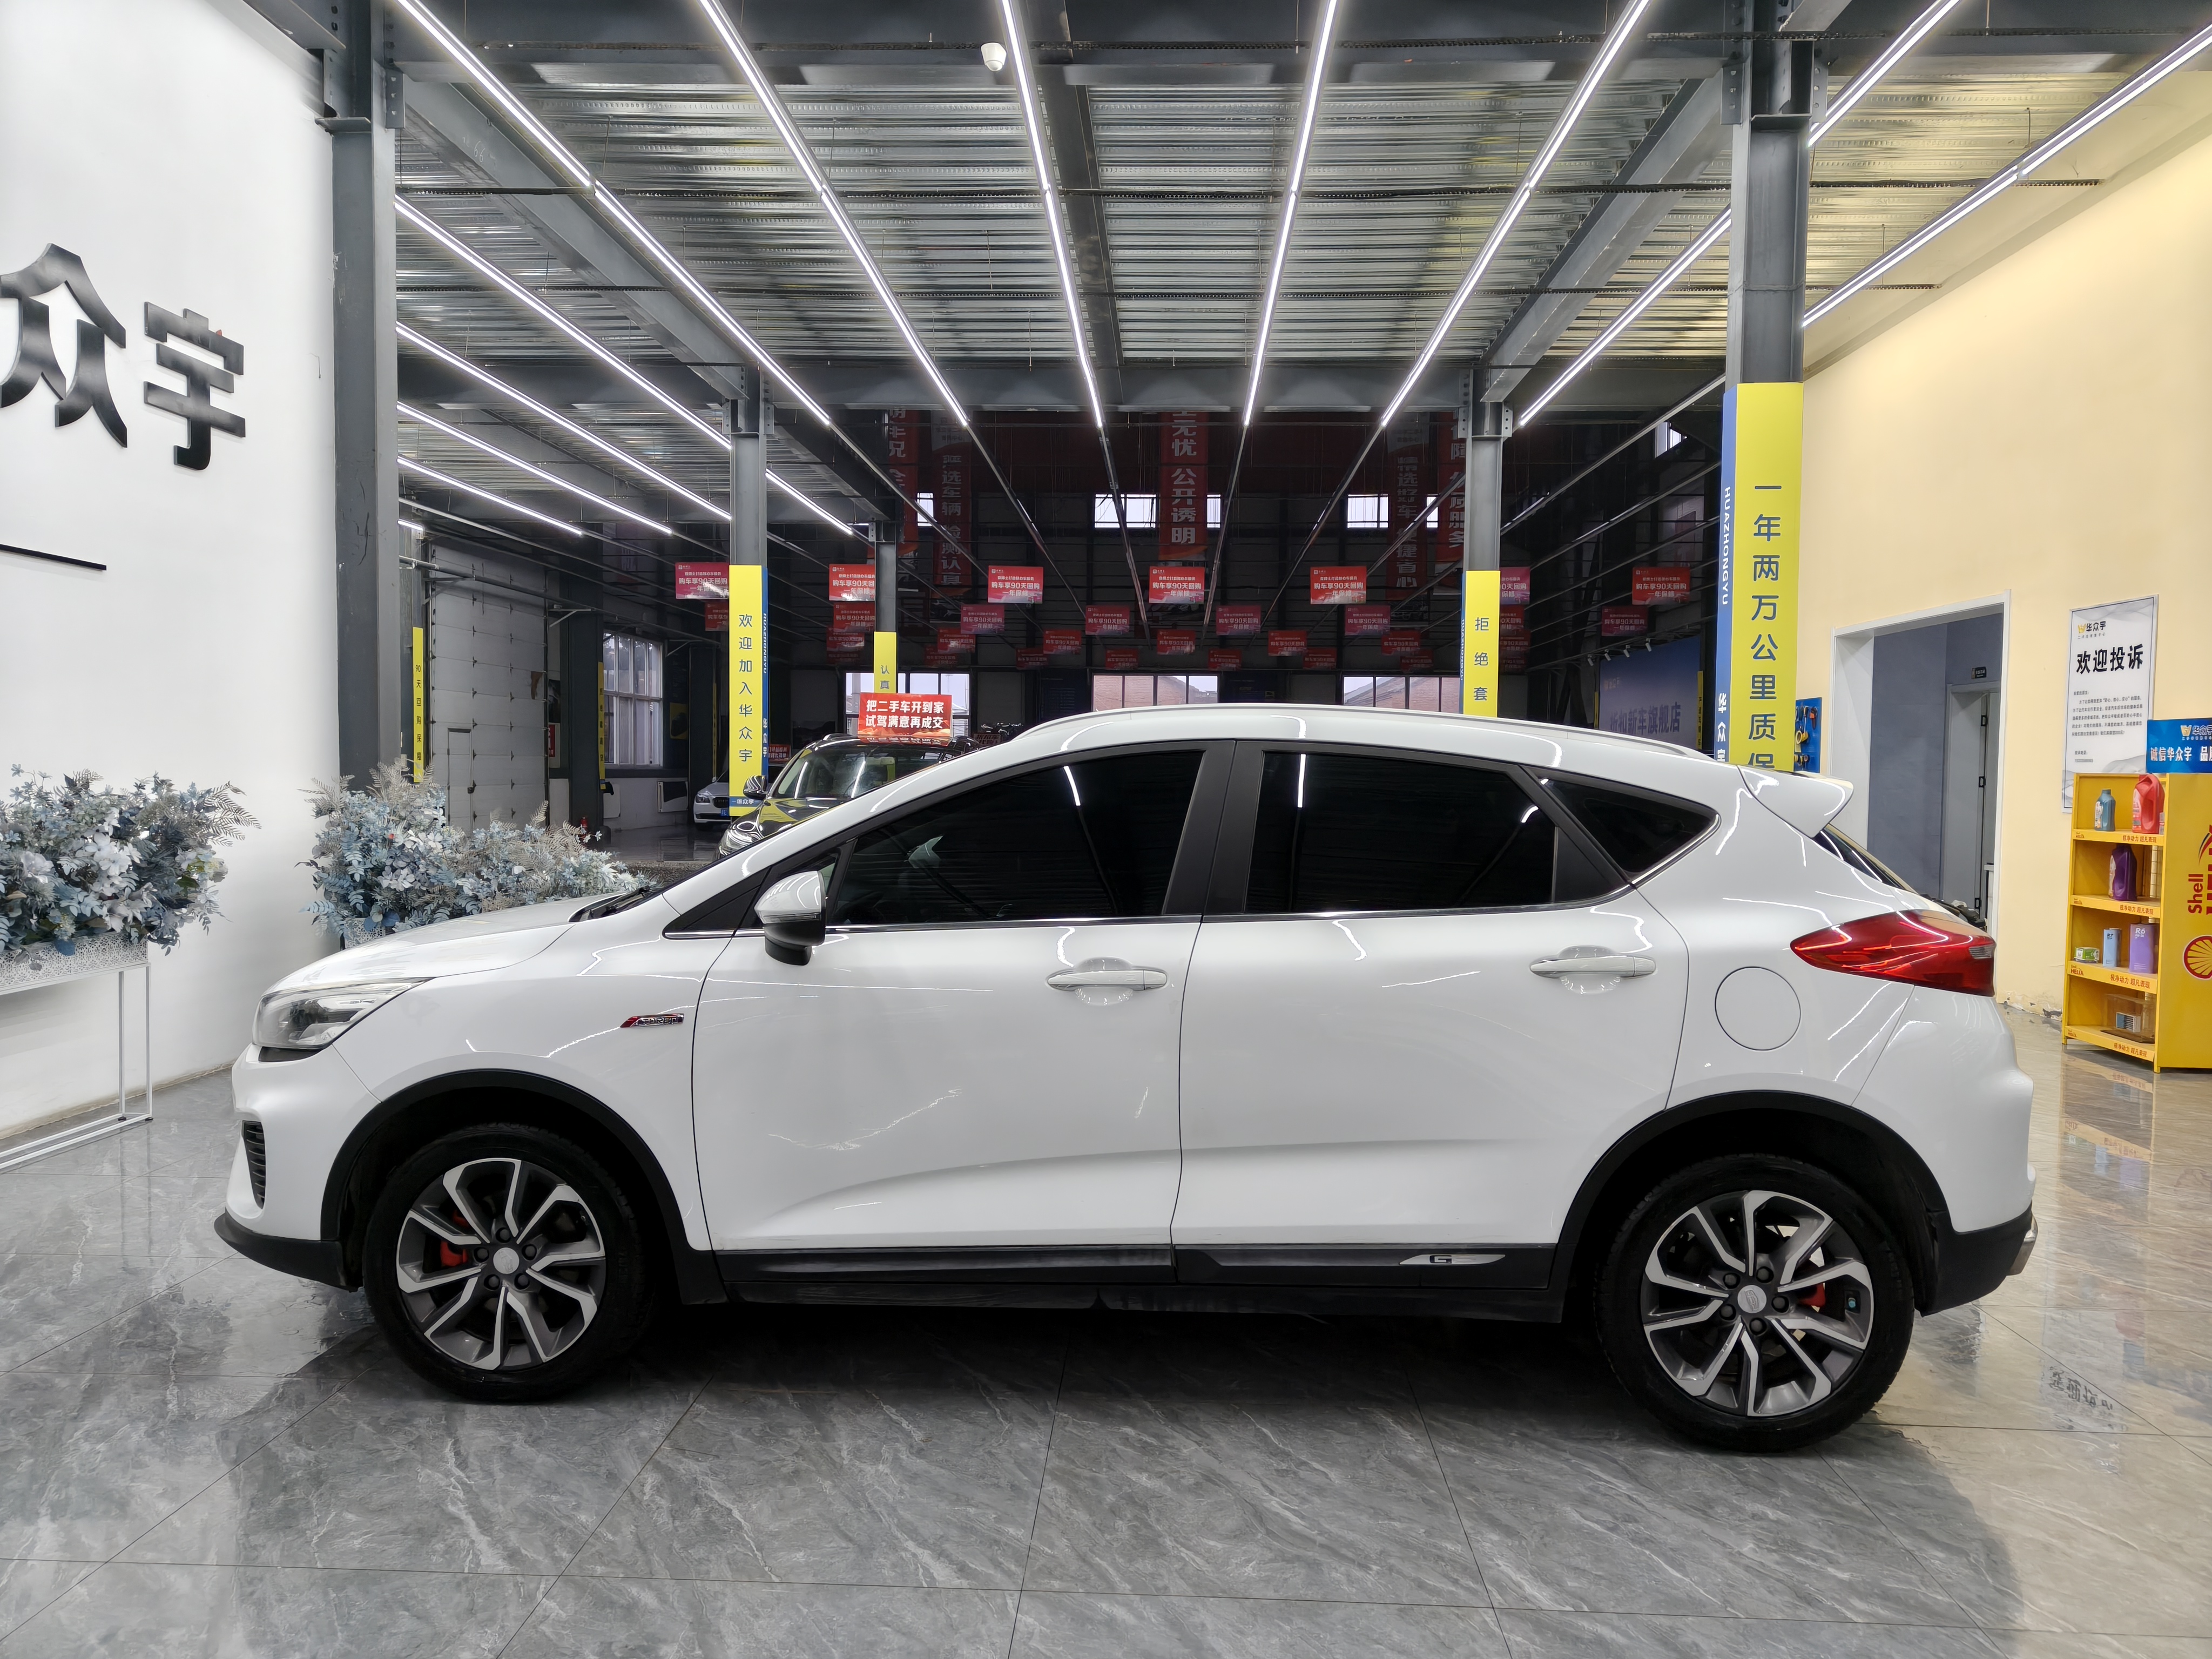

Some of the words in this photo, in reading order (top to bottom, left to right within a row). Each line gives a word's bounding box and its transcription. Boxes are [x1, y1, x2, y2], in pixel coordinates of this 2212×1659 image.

[1171, 411, 1197, 457] 无忧
[1722, 487, 1731, 605] HUAZHONGYU
[991, 582, 1040, 590] 购车享90天回购
[1748, 485, 1782, 770] 一年两万公里质保
[2076, 644, 2143, 675] 欢迎投诉
[738, 614, 753, 763] 欢迎加入华众宇
[866, 699, 944, 714] 把二手车开到家
[865, 714, 943, 729] 试驾满意再成交
[2187, 873, 2203, 914] Shell
